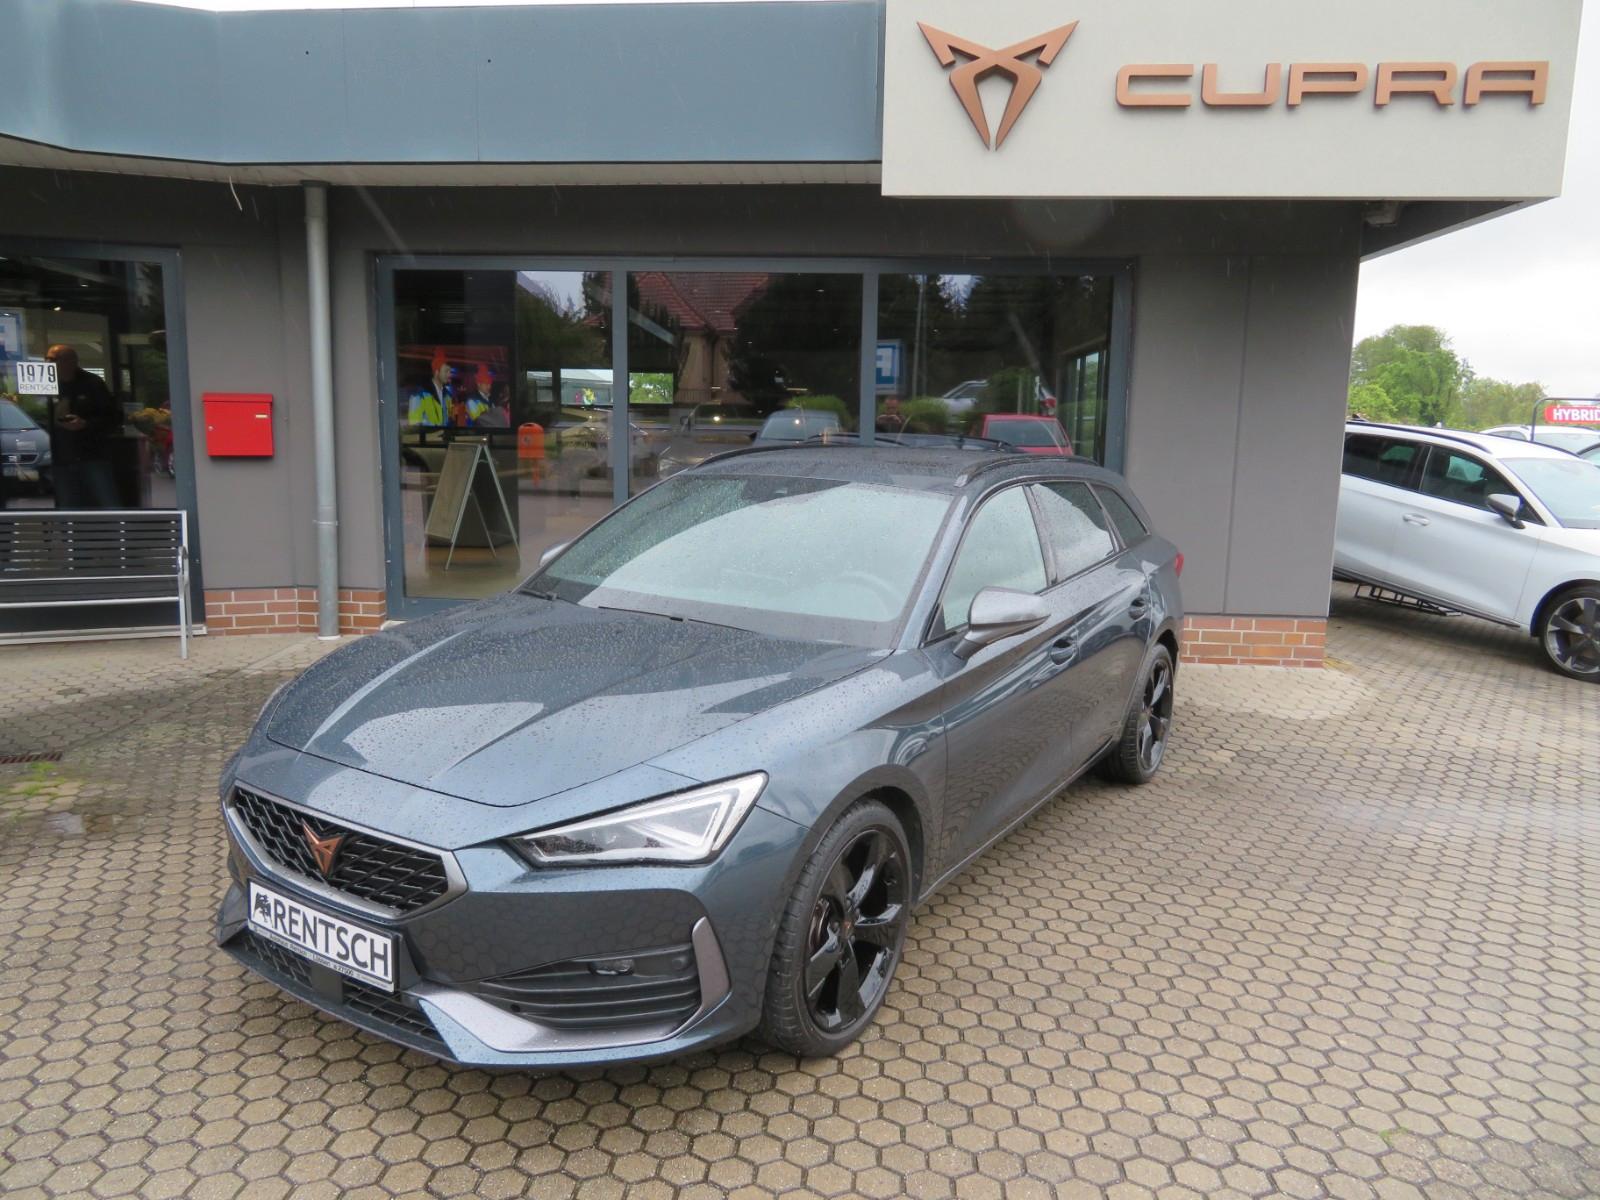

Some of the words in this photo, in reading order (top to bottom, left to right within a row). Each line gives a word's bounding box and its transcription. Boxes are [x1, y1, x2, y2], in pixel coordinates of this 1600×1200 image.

[1115, 60, 1549, 107] CUPRA
[18, 364, 57, 383] 1979
[273, 898, 389, 978] RENTSCH
